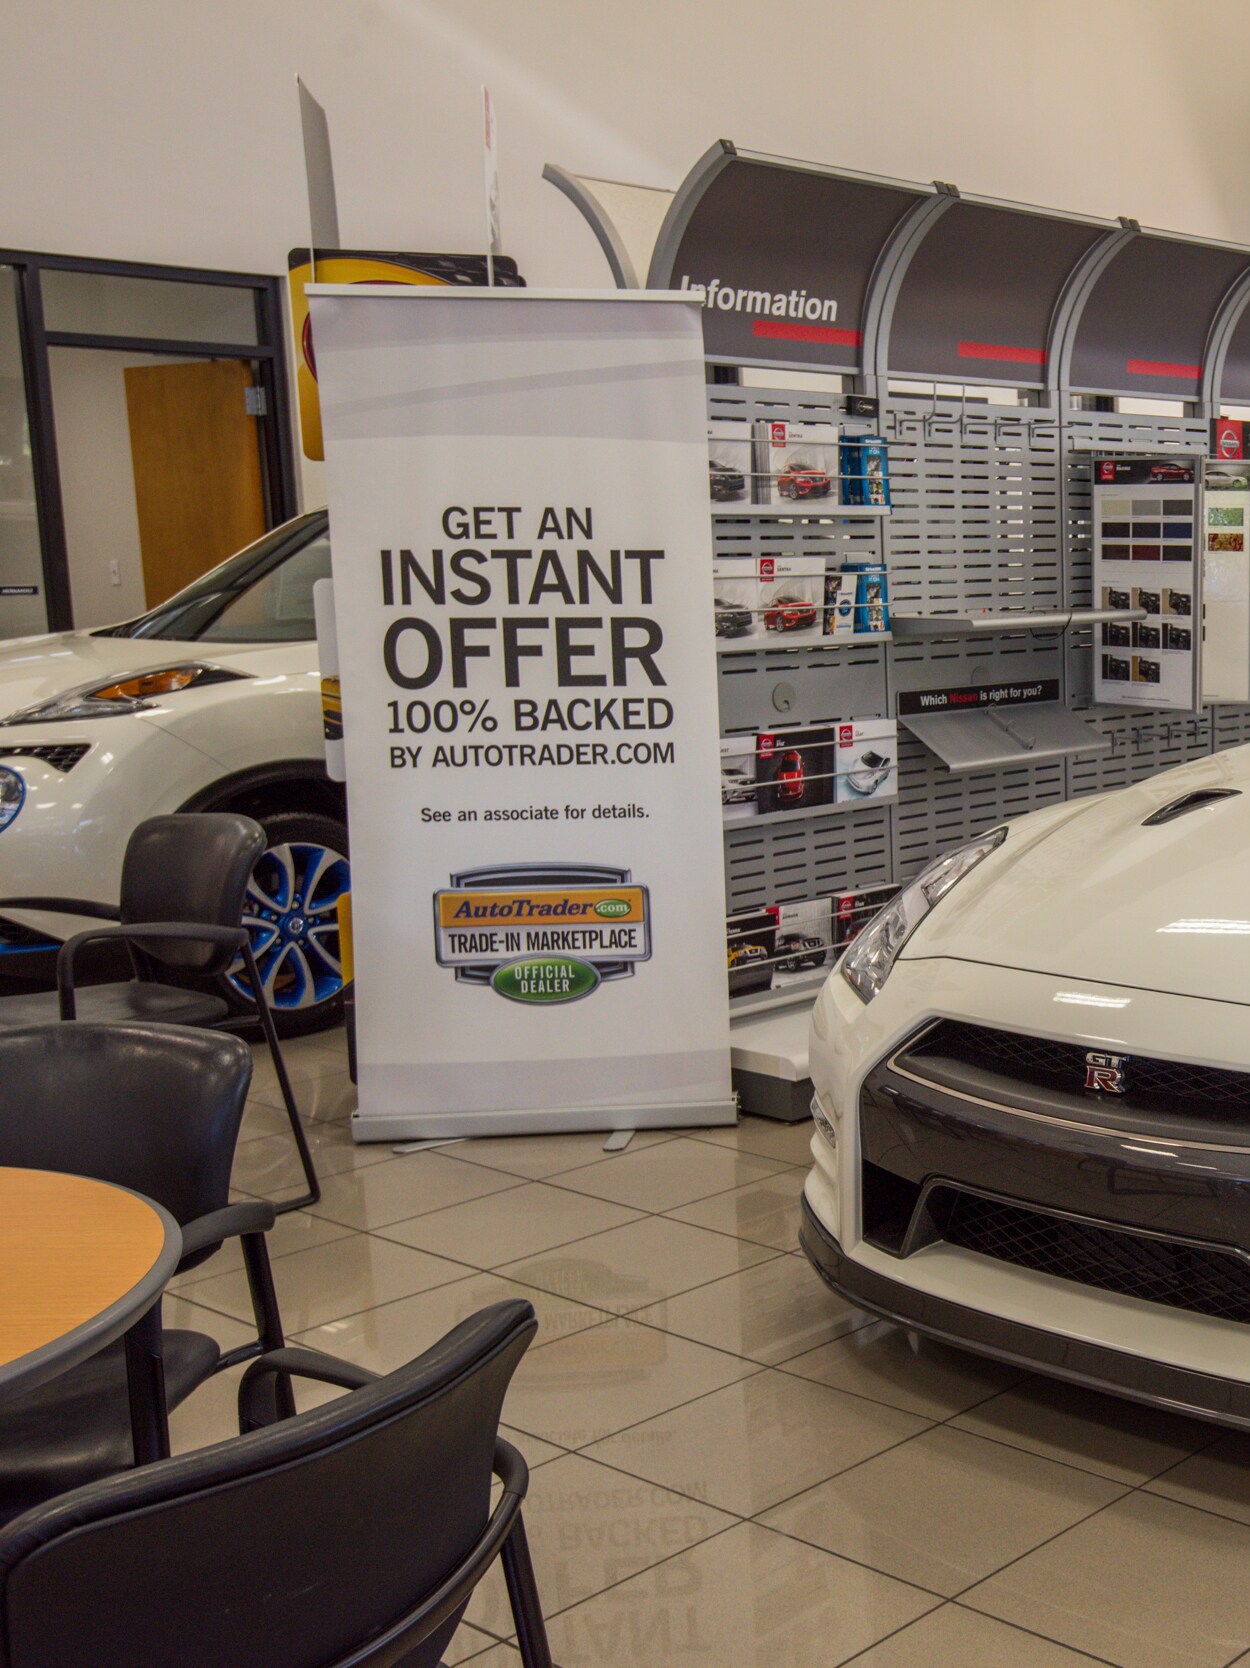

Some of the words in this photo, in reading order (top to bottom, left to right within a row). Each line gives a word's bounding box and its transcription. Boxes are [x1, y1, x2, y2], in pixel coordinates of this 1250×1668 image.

[442, 506, 522, 540] GET
[537, 506, 593, 540] AN
[380, 548, 665, 606] INSTANT
[383, 616, 667, 690] OFFER
[920, 694, 947, 706] Which
[949, 691, 978, 704] Nissan
[980, 690, 988, 700] is
[989, 689, 1008, 702] right
[1010, 687, 1021, 698] for
[1022, 685, 1043, 699] you?
[387, 699, 499, 734] 100%
[514, 697, 674, 732] BACKED
[390, 746, 423, 768] BY
[431, 742, 675, 768] AUTOTRADER.COM
[421, 807, 452, 823] See
[457, 809, 478, 822] an
[483, 805, 559, 822] associate
[564, 804, 586, 820] for
[592, 803, 650, 819] details.
[448, 932, 520, 954] TRADE-IN
[526, 928, 637, 952] MARKETPLACE
[514, 965, 575, 981] OFFICIAL
[520, 979, 570, 994] DEALER
